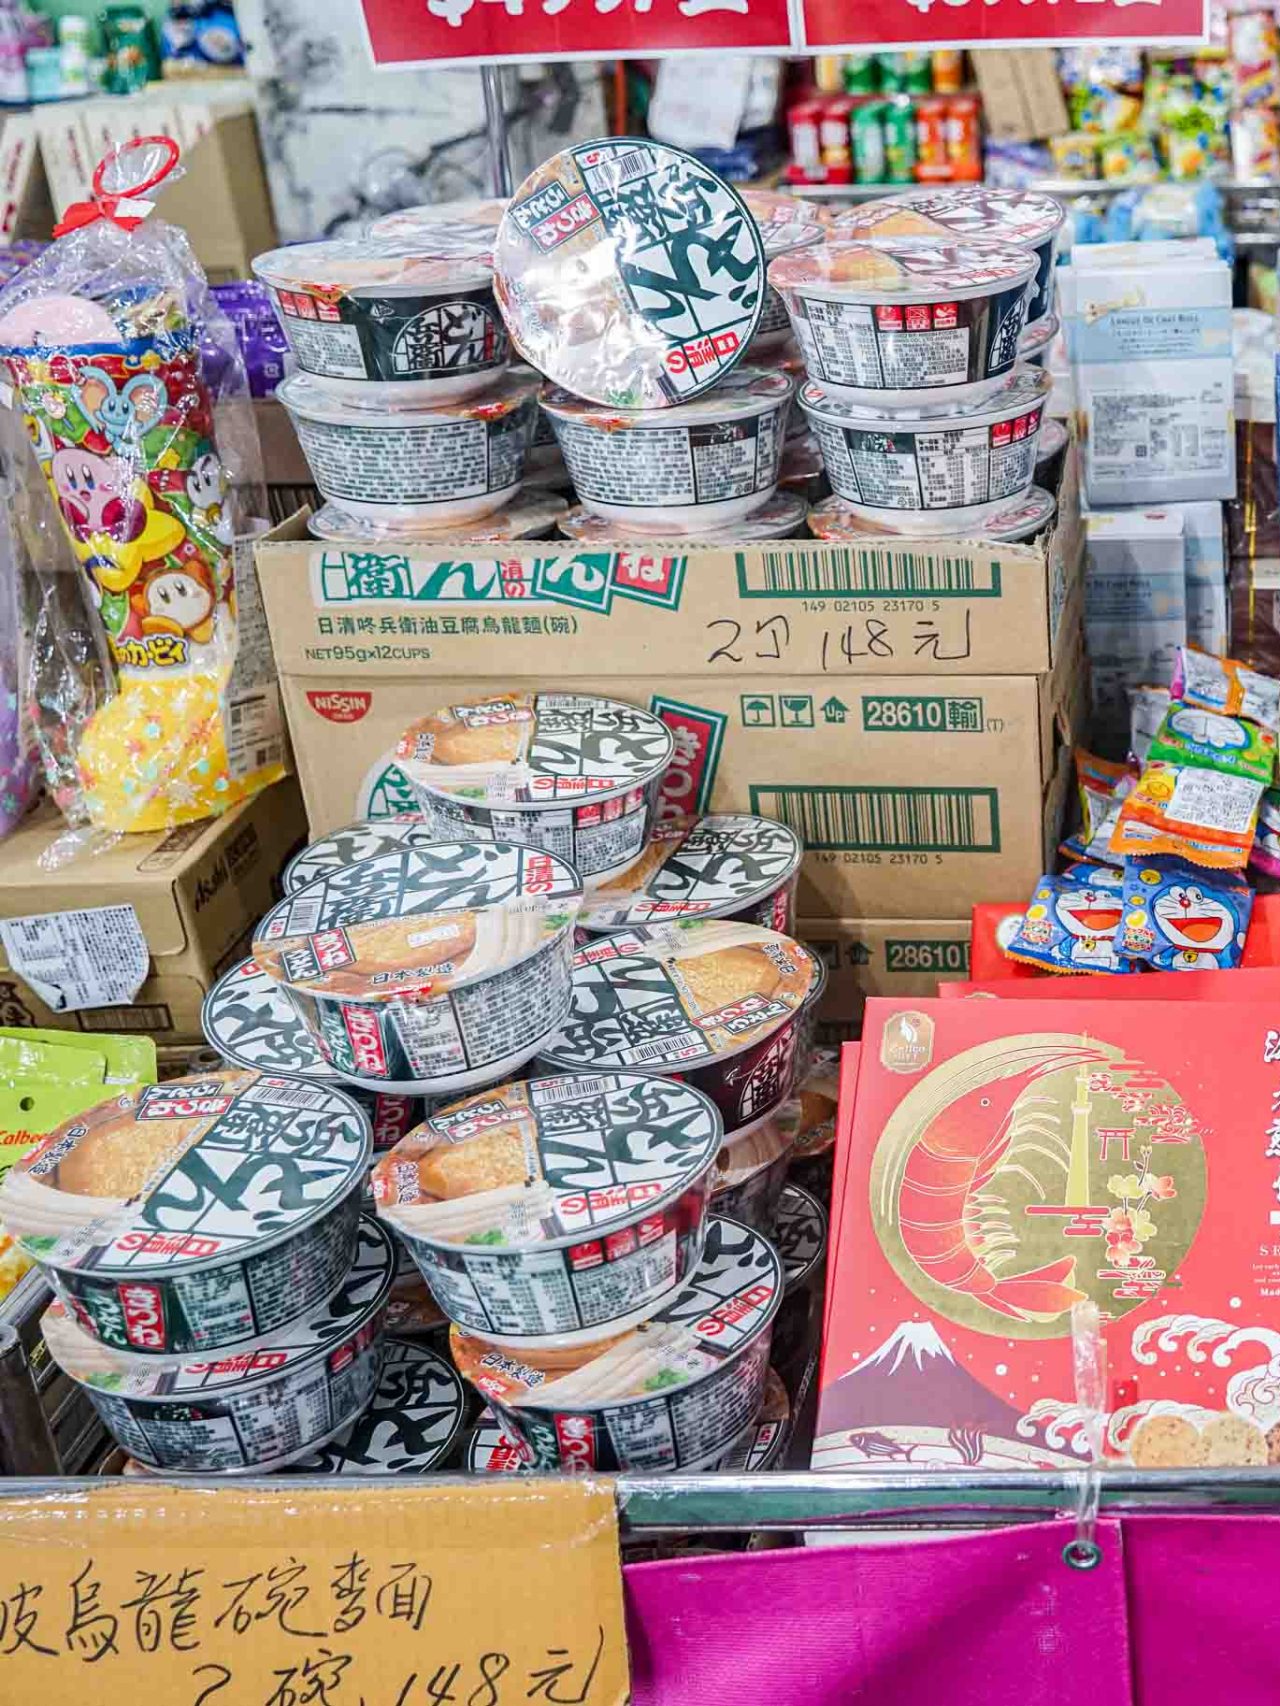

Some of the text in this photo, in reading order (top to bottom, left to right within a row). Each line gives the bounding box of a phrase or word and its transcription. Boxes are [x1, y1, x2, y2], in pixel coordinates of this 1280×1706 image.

[313, 691, 367, 712] NISSIN
[866, 700, 943, 729] 28610
[887, 946, 966, 969] 28610
